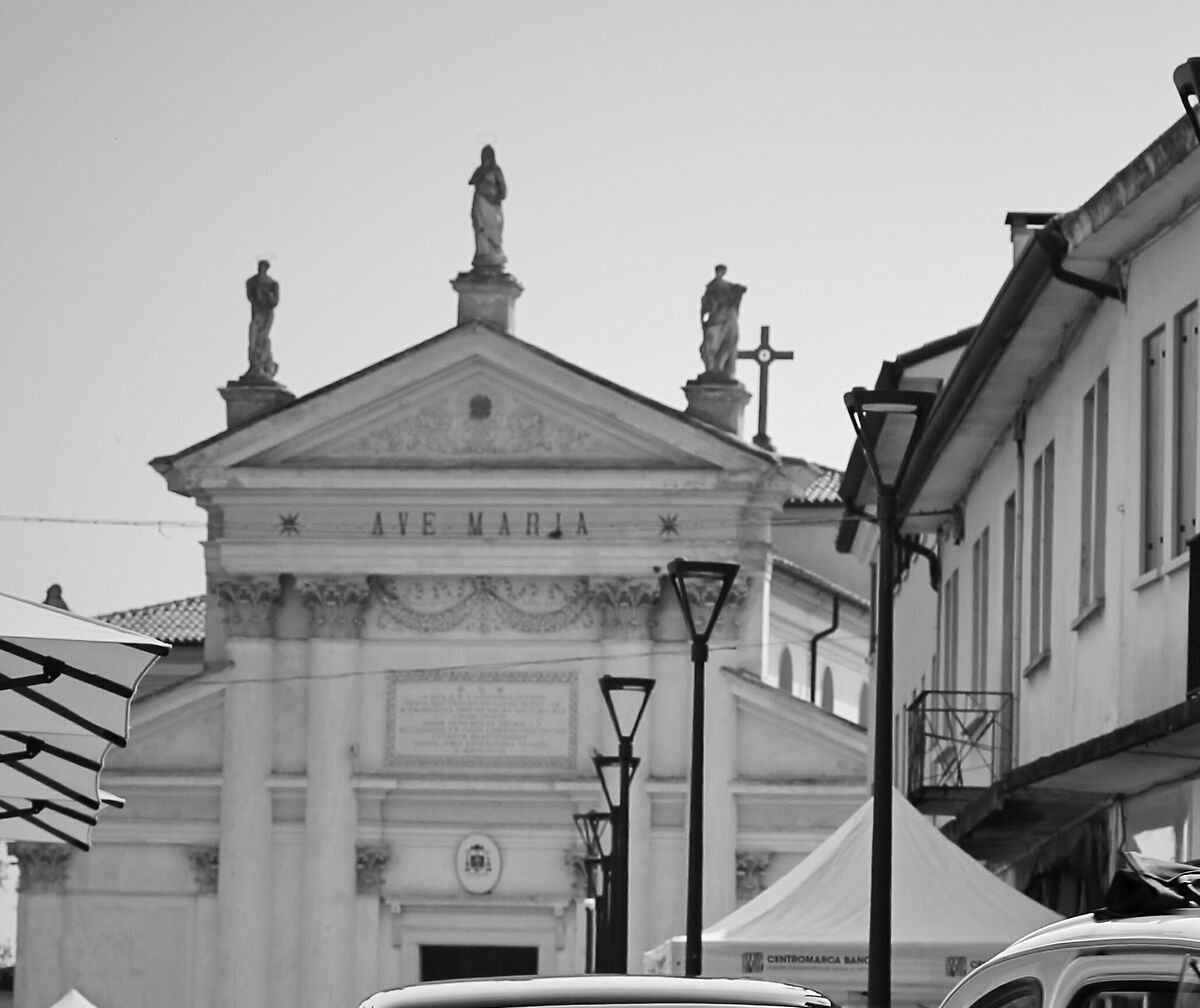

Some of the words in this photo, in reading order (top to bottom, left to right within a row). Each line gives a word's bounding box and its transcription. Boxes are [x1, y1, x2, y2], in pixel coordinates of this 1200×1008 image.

[371, 511, 436, 536] AVE
[467, 511, 589, 538] MARIA
[766, 954, 842, 965] CENTROMARCA
[844, 955, 869, 965] BANC
